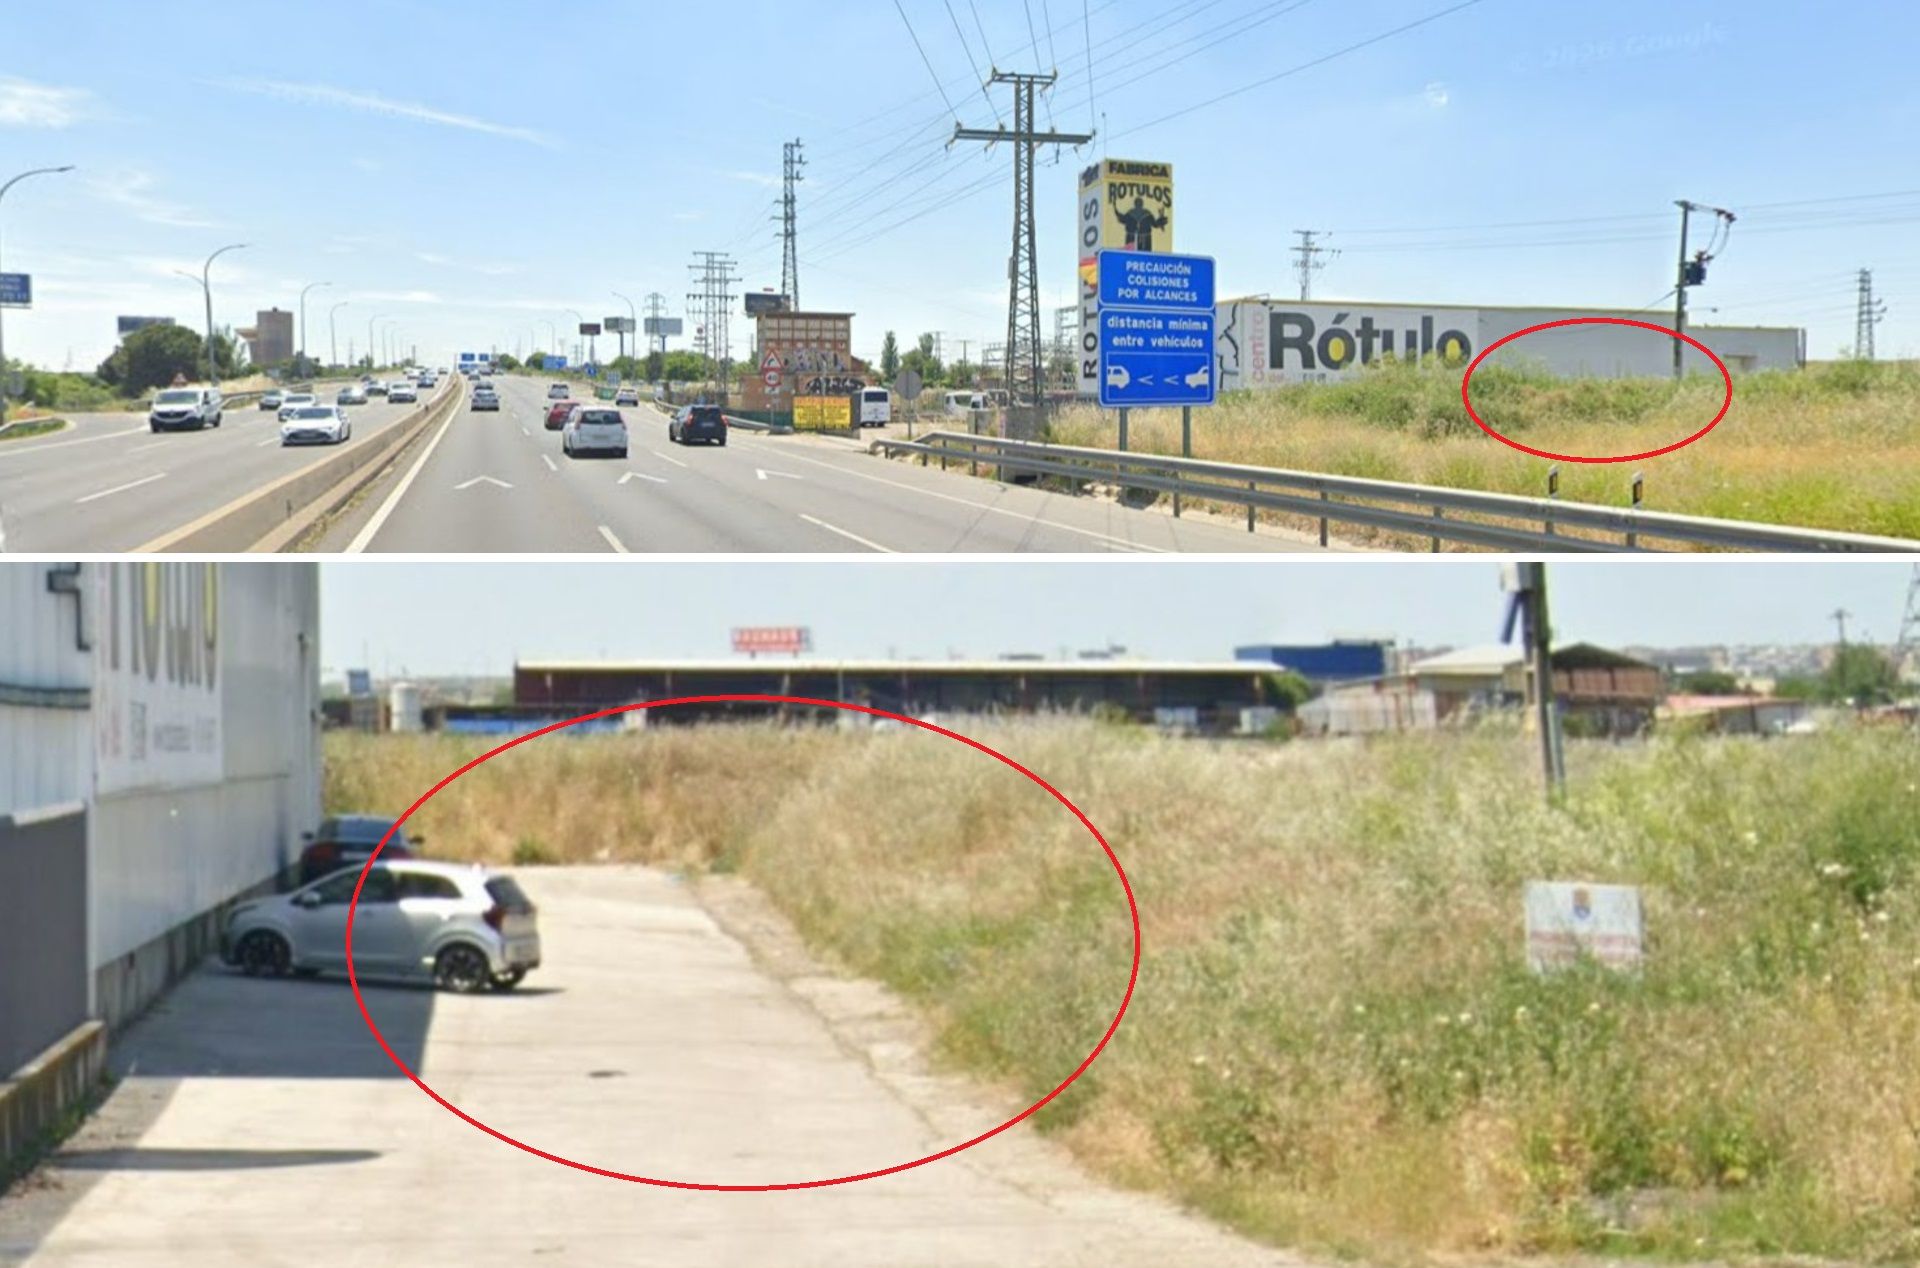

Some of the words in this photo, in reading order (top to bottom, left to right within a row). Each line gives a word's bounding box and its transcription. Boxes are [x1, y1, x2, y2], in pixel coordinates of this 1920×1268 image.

[1109, 161, 1169, 178] FABRICA
[1108, 182, 1172, 208] ROTULOS
[1126, 261, 1191, 275] PRECAUCIÓN
[1128, 275, 1189, 288] COLISIONES
[1118, 288, 1139, 299] POR
[1145, 291, 1197, 302] ALCANCES
[1107, 316, 1163, 330] distancia
[1168, 318, 1208, 331] mínima
[1112, 336, 1144, 347] entre
[1151, 336, 1203, 348] vehículos
[1269, 312, 1472, 370] Rótulo
